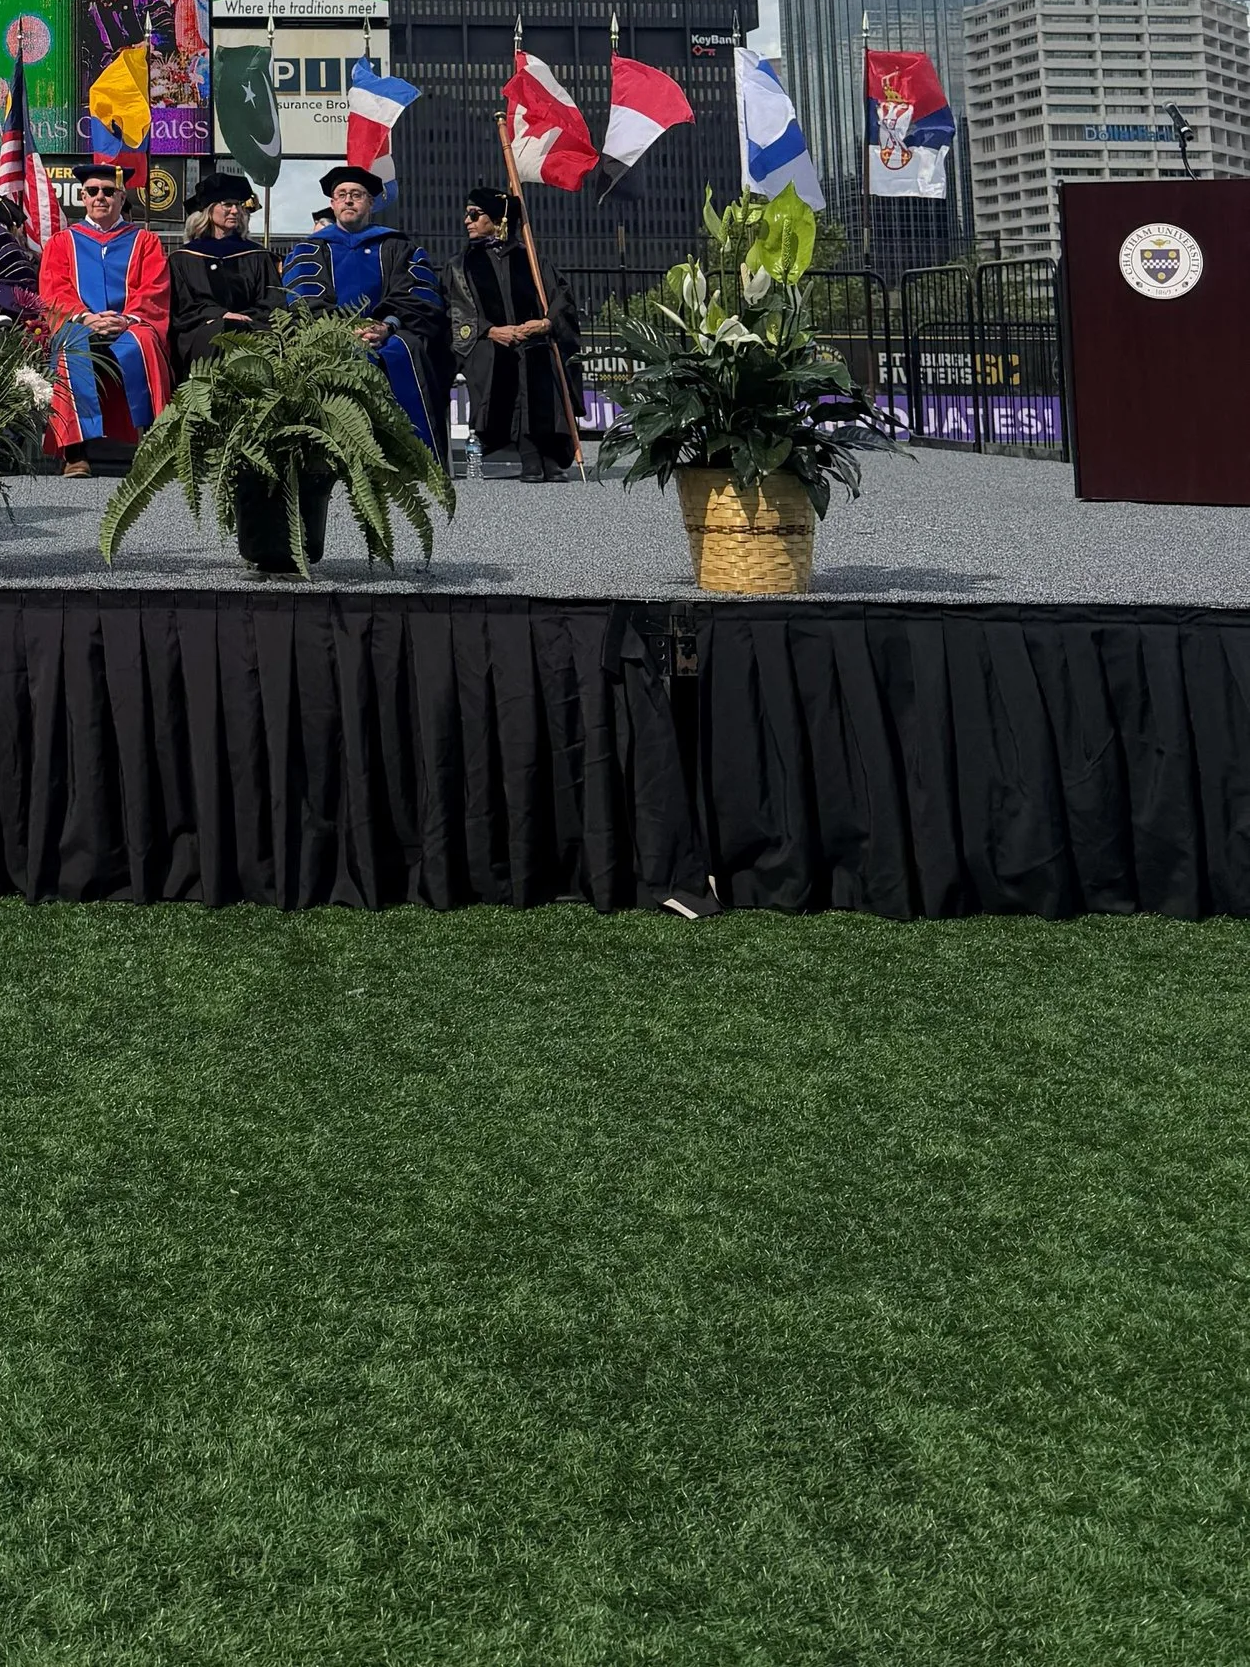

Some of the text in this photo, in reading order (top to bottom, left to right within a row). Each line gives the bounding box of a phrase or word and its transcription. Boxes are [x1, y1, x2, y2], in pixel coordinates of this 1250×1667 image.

[225, 0, 376, 14] Where the traditions meet
[277, 102, 323, 110] surance
[314, 113, 348, 123] Consu
[1123, 227, 1200, 276] CHATHAM UNIVERSITY
